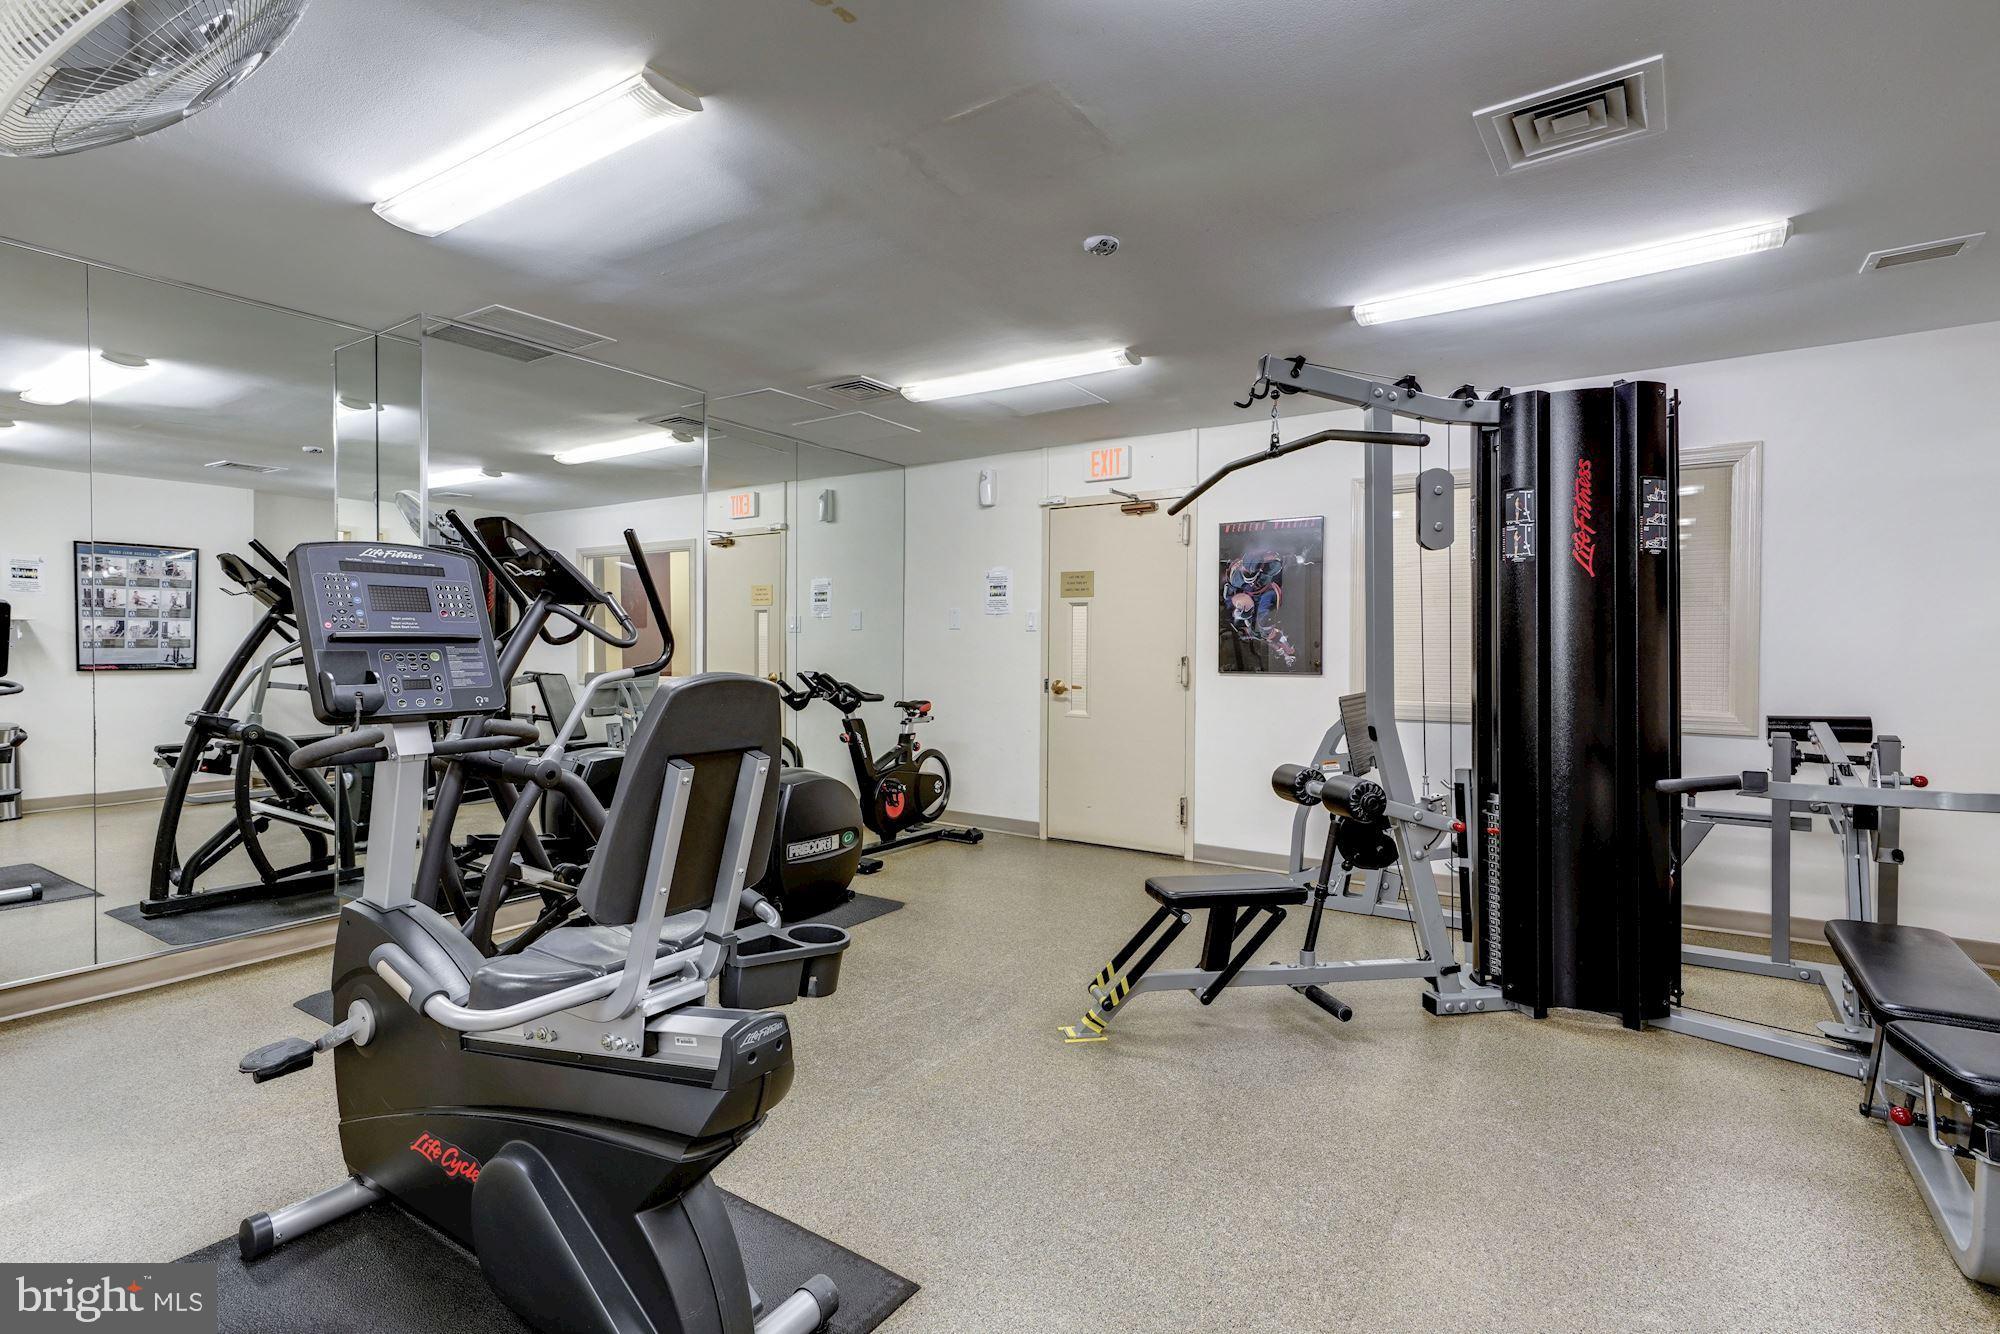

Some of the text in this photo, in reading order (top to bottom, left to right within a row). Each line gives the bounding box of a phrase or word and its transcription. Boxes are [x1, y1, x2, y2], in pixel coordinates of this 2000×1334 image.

[1091, 448, 1122, 478] EXIT
[410, 1134, 480, 1183] Life Cycle
